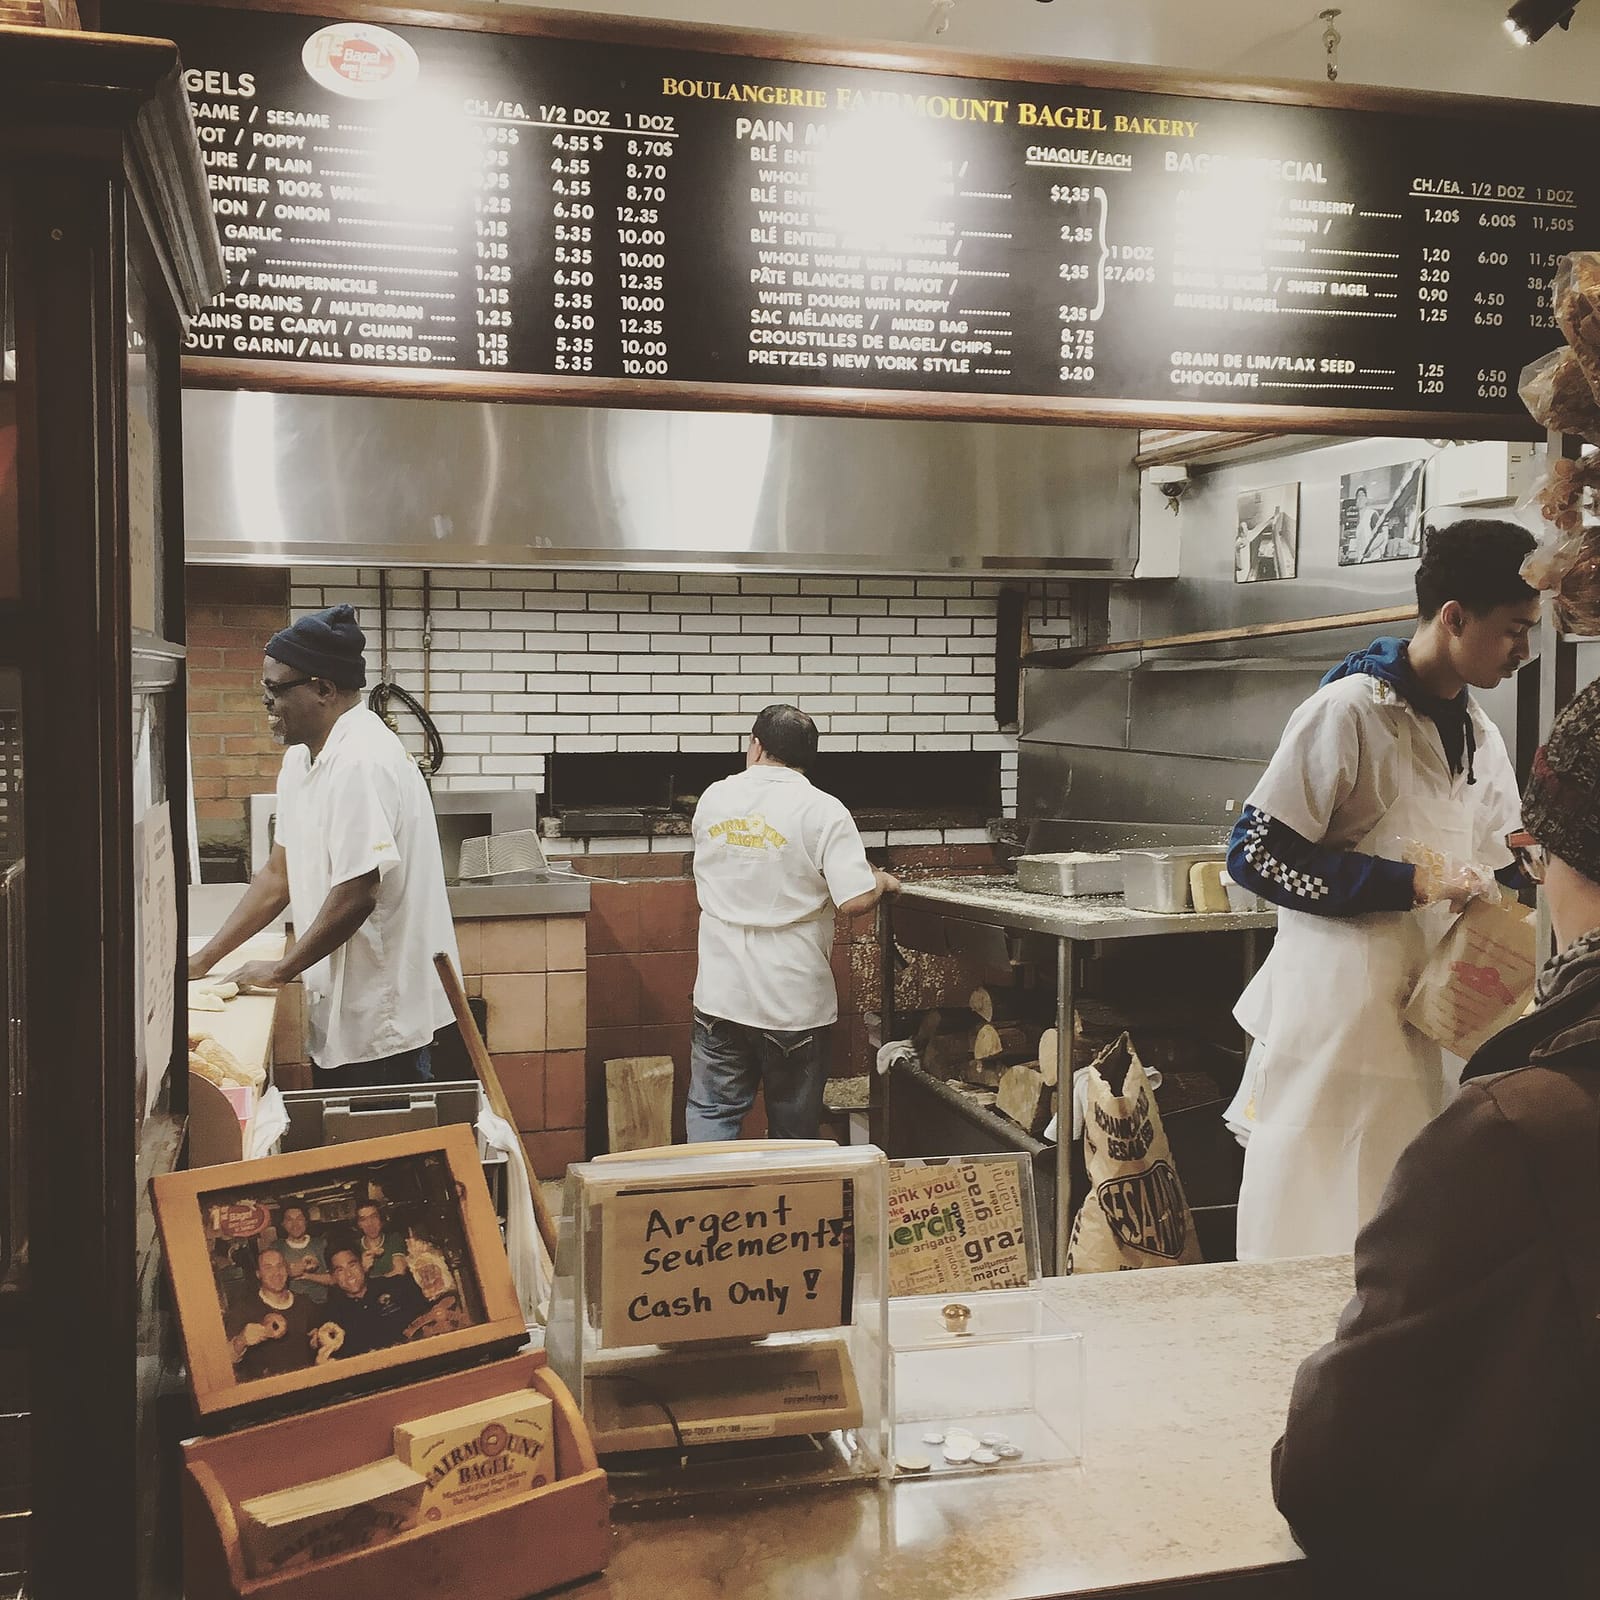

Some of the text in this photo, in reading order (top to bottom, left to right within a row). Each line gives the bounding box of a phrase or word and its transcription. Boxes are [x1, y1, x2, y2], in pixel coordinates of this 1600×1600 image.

[539, 105, 567, 123] 1/2
[573, 108, 610, 126] DOZ
[625, 113, 632, 128] 1
[638, 114, 675, 132] DOZ
[662, 78, 827, 108] BOULANGERIE
[1018, 102, 1108, 131] BAGEL
[1114, 115, 1199, 138] BAKERY
[266, 110, 330, 129] SESAME
[627, 140, 674, 157] 8,70$
[736, 117, 794, 143] PAIN
[252, 132, 306, 150] POPPY
[550, 157, 590, 175] 4,55
[626, 163, 667, 180] 8,70
[750, 145, 777, 163] BLÉ
[1026, 145, 1132, 167] CHAQUE/EACH
[208, 174, 269, 194] ENTIER
[276, 178, 323, 199] 100%
[265, 156, 312, 174] PLAIN
[552, 179, 591, 196] 4,55
[626, 186, 666, 202] 8,70
[759, 169, 1090, 204] WHOLE $2,35
[1412, 178, 1575, 203] CH./EA. 1/2 DOZ 1 DOZ
[750, 185, 777, 203] BLÉ
[274, 204, 666, 245] ONION 1,15 5,35 10,00
[553, 202, 595, 220] 6,50
[616, 206, 659, 224] 12,35
[759, 210, 1093, 242] WHOLE 2,35
[1424, 209, 1460, 224] 1,20$
[1478, 213, 1517, 228] 6,00$
[225, 224, 665, 269] GARLIC 1,15 5,35 10,00
[750, 227, 777, 244] BLÉ
[759, 251, 809, 267] WHOLE
[1059, 263, 1089, 281] 2,35
[1122, 246, 1154, 260] DOZ
[1422, 248, 1450, 262] 1,20
[1477, 252, 1508, 266] 6,00
[475, 264, 663, 290] 1,25 6,50 12,35
[750, 267, 943, 295] PÂTE BLANCHE ET PAVOT
[1419, 269, 1450, 283] 3,20
[258, 273, 665, 312] PUMPERNICKLE 1,15 5,35 10,00
[1331, 283, 1369, 298] BAGEL
[1418, 287, 1448, 302] 0,90
[1474, 292, 1505, 306] 4,50
[329, 300, 663, 335] MULTIGRAIN 1,25 6,50 12,35
[759, 291, 1088, 323] WHITE DOUGH WITH POPPY 2,35
[1419, 308, 1448, 322] 1,25
[1474, 312, 1503, 326] 6,50
[249, 315, 274, 331] DE
[281, 317, 337, 336] CARVI
[358, 322, 413, 339] CUMIN
[477, 333, 508, 349] 1,15
[556, 337, 594, 353] 5,35
[621, 339, 667, 356] 10,00
[750, 308, 1095, 345] SAC MÉLANGE MIXED BAG 8,75
[749, 329, 857, 349] CROUSTILLES
[862, 334, 884, 350] DE
[951, 340, 993, 355] CHIPS
[1060, 344, 1094, 361] 8,75
[477, 350, 509, 365] 1,15
[554, 355, 593, 371] 5,35
[622, 359, 668, 375] 10,00
[748, 349, 1095, 381] PRETZELS NEW YORK STYLE 3,20
[1171, 351, 1507, 383] GRAIN DE LIN/FLAX SEED 1,25 6,50
[1170, 370, 1507, 399] CHOCOLATE 1,20 6,00
[923, 1181, 955, 1199] you
[645, 1195, 793, 1247] Argent
[903, 1202, 939, 1224] akpé
[888, 1207, 956, 1250] erci
[973, 1262, 1010, 1281] marci
[628, 1287, 712, 1322] Cash
[728, 1278, 789, 1315] Only
